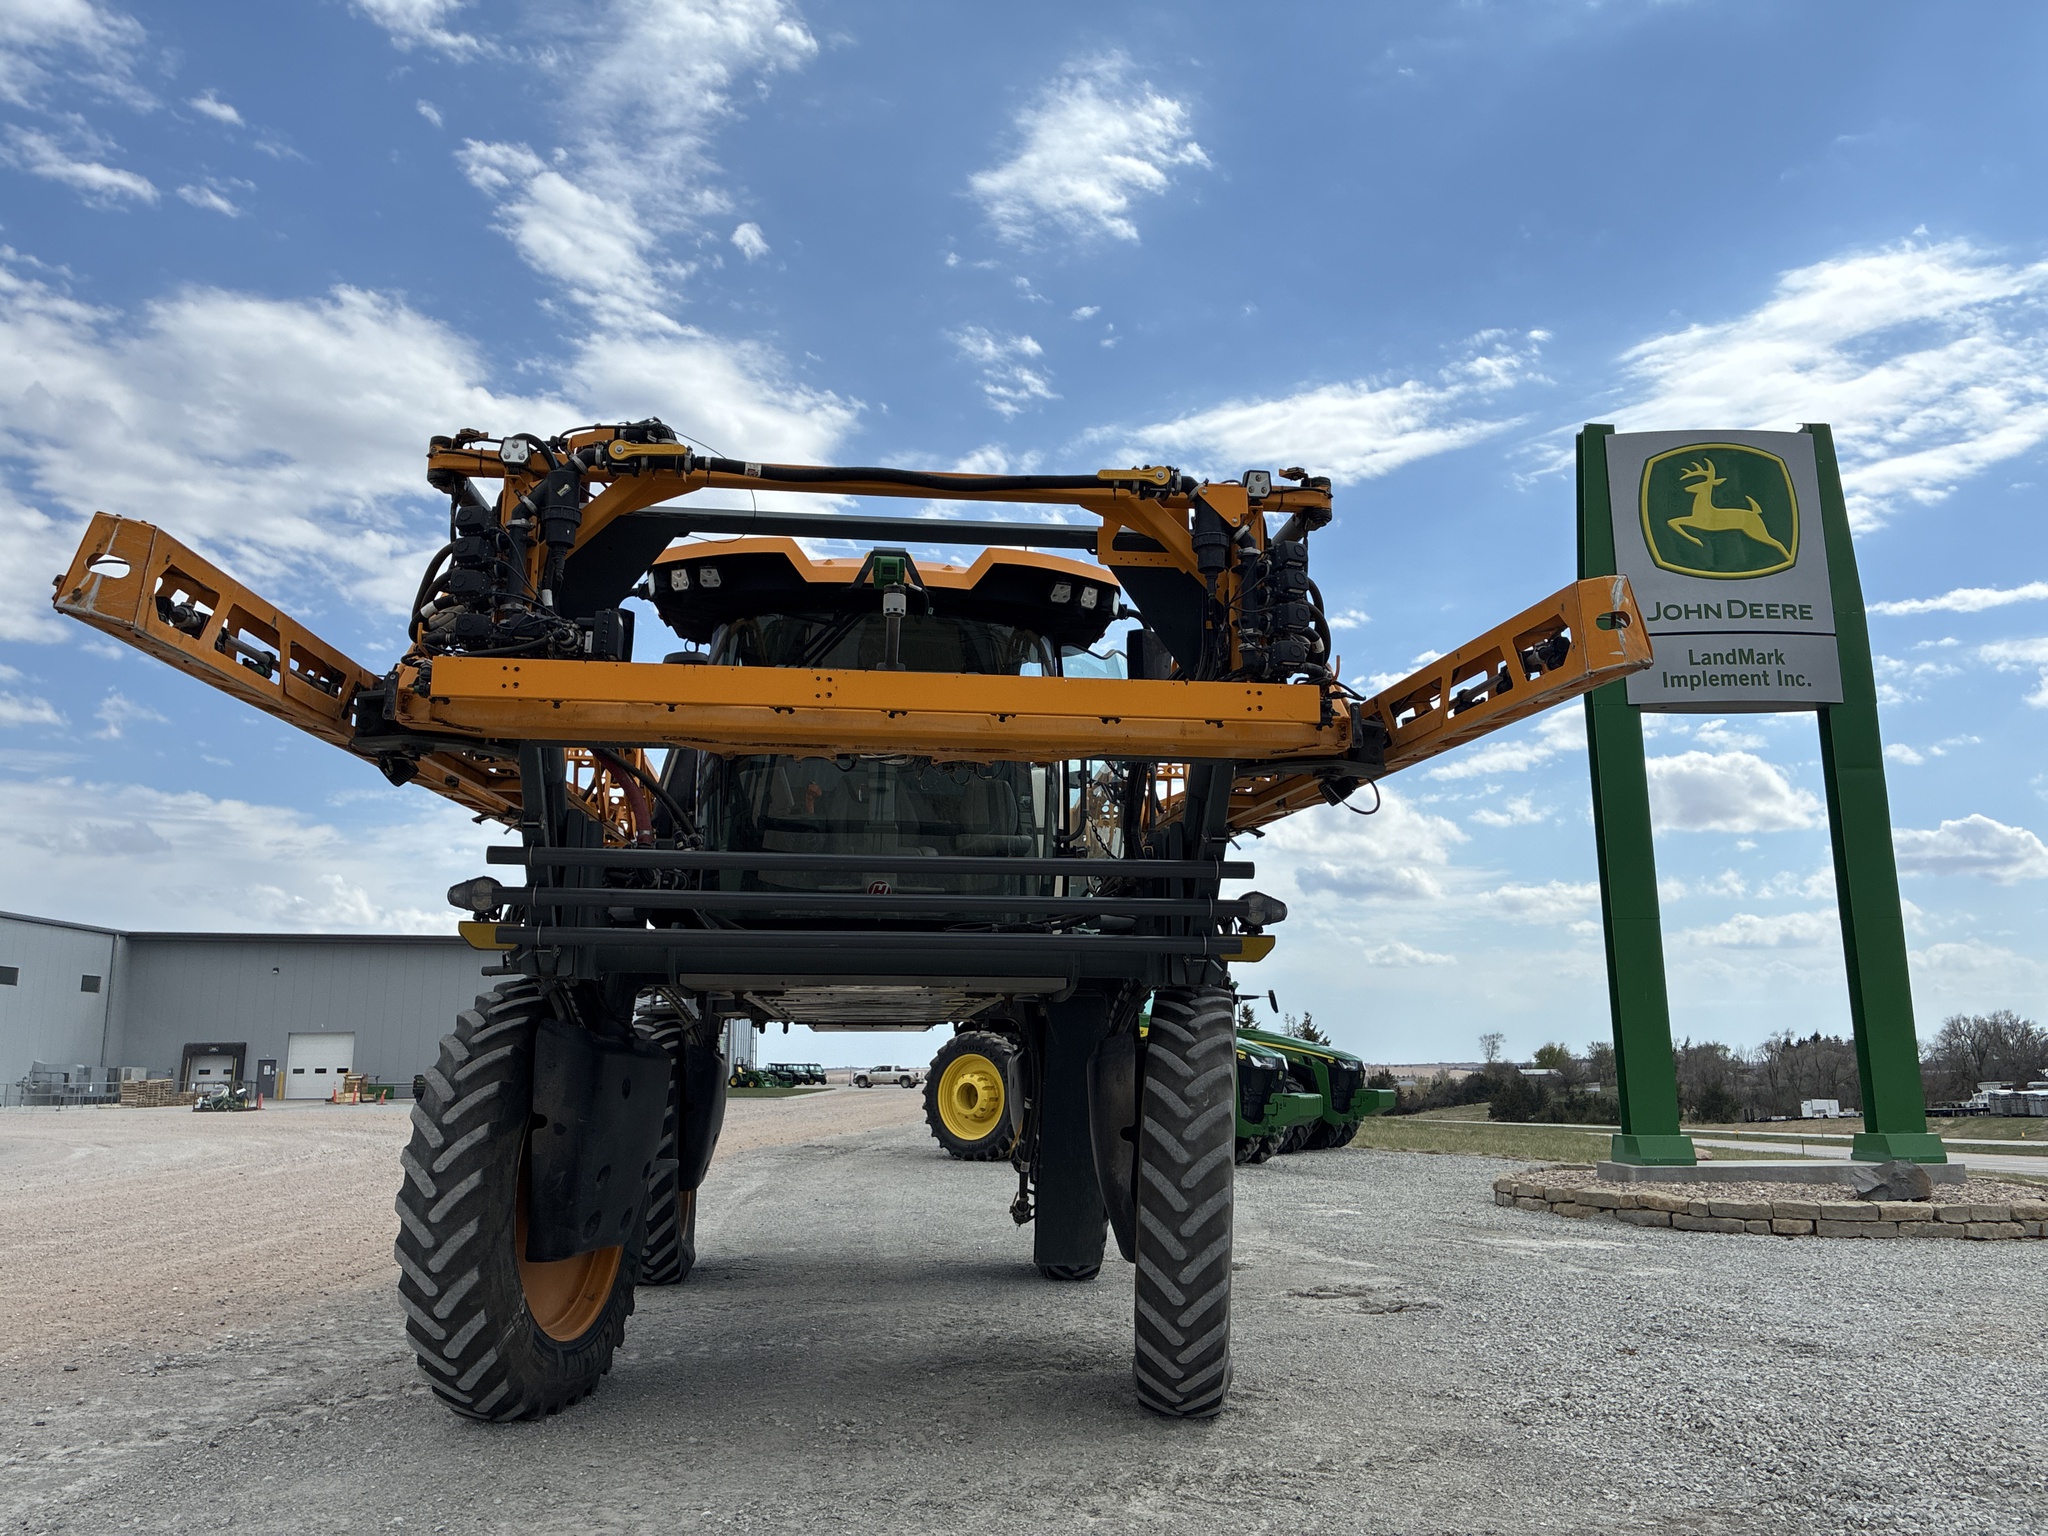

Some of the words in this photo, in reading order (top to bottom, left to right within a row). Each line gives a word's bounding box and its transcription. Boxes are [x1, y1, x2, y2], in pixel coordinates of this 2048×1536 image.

[1646, 601, 1722, 621] JOHN
[1726, 599, 1813, 620] DEERE
[1688, 648, 1786, 666] LandMark
[1662, 670, 1770, 691] Implement
[1777, 669, 1812, 687] Inc.
